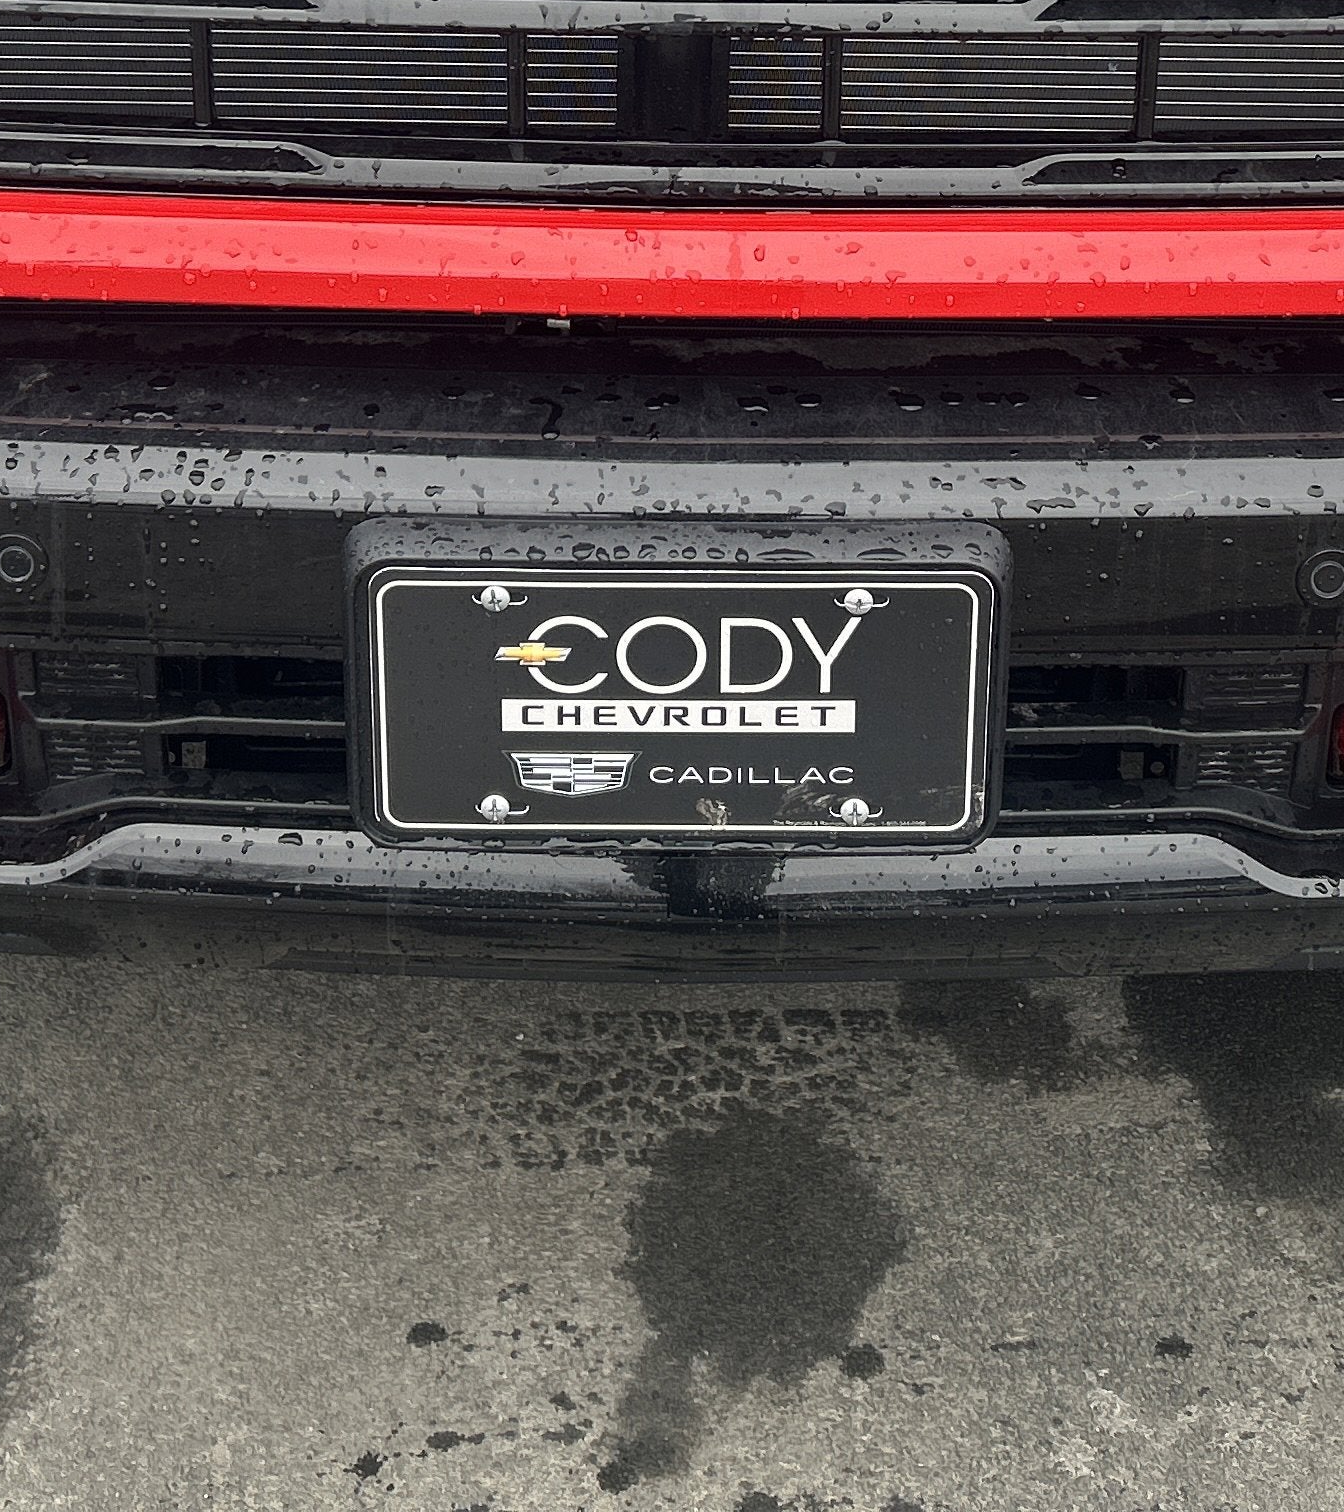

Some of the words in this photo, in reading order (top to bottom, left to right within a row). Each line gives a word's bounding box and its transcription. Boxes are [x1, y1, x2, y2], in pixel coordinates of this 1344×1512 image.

[527, 615, 862, 694] CODY
[521, 704, 836, 727] CHEVROLET
[649, 766, 855, 785] CADILLAC
